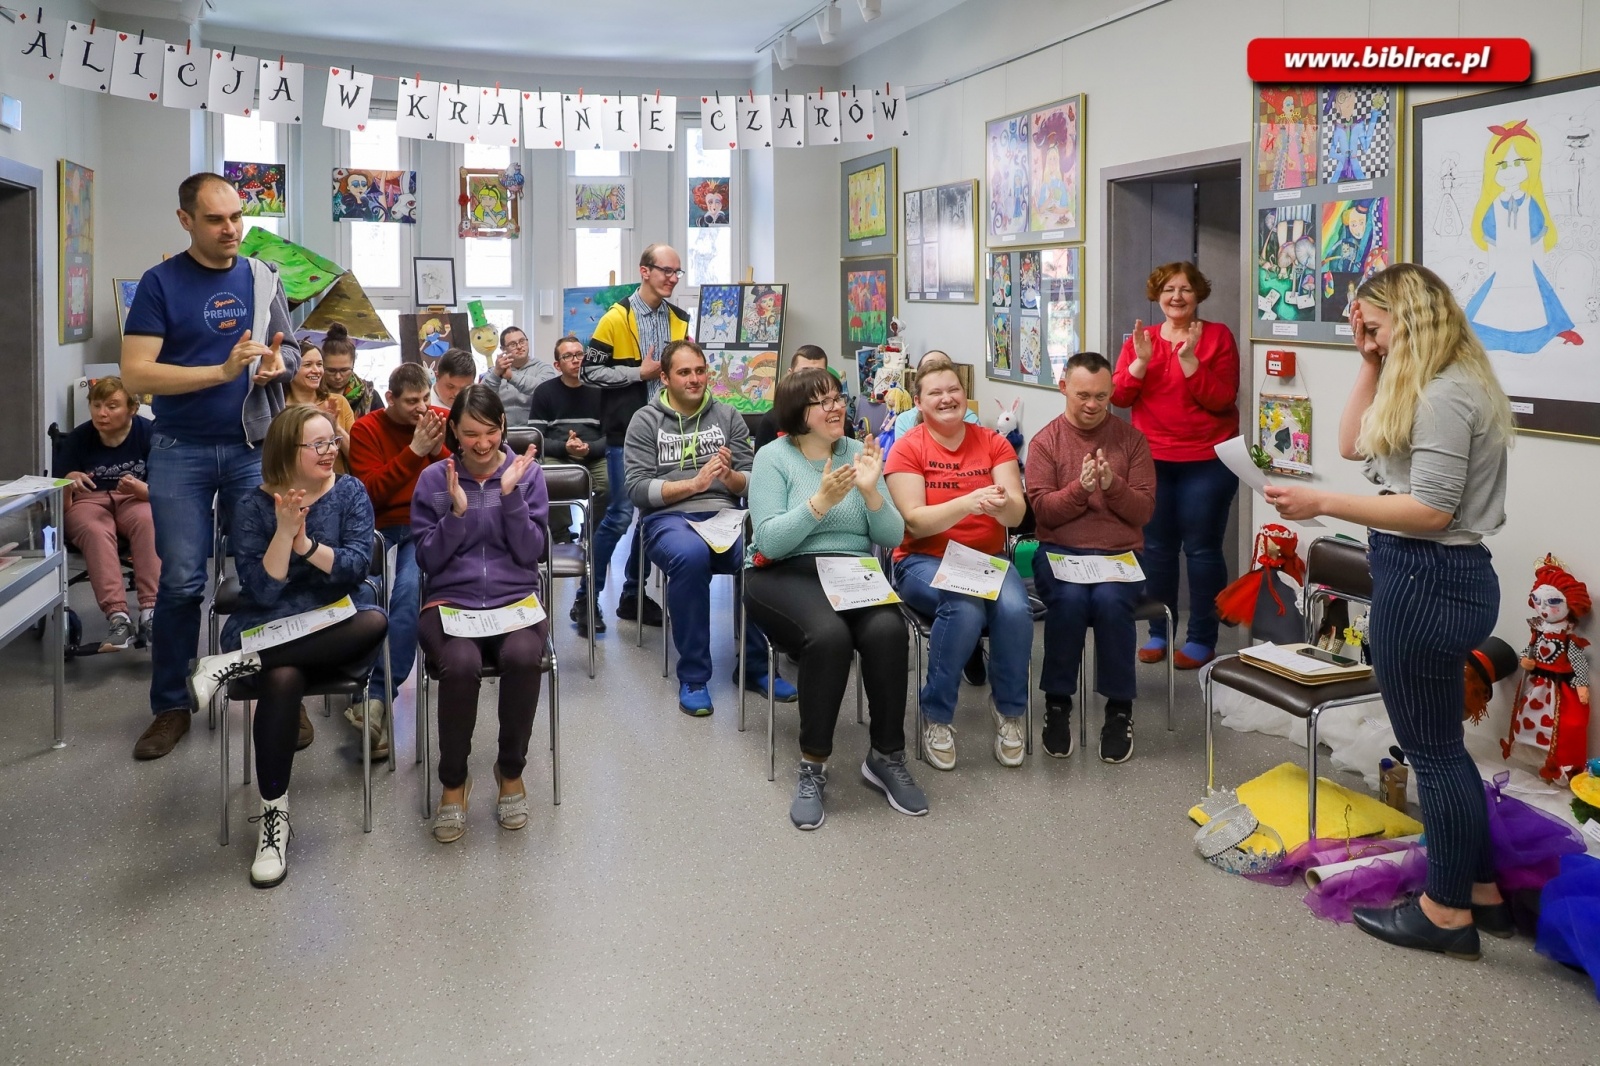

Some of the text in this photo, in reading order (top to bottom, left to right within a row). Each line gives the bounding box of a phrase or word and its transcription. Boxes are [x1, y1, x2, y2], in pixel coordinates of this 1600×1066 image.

[21, 30, 899, 132] ALICJA W KRAINIE CZARÓW
[203, 307, 248, 319] PREMIUM
[661, 442, 682, 461] NEW
[928, 460, 960, 470] WORK
